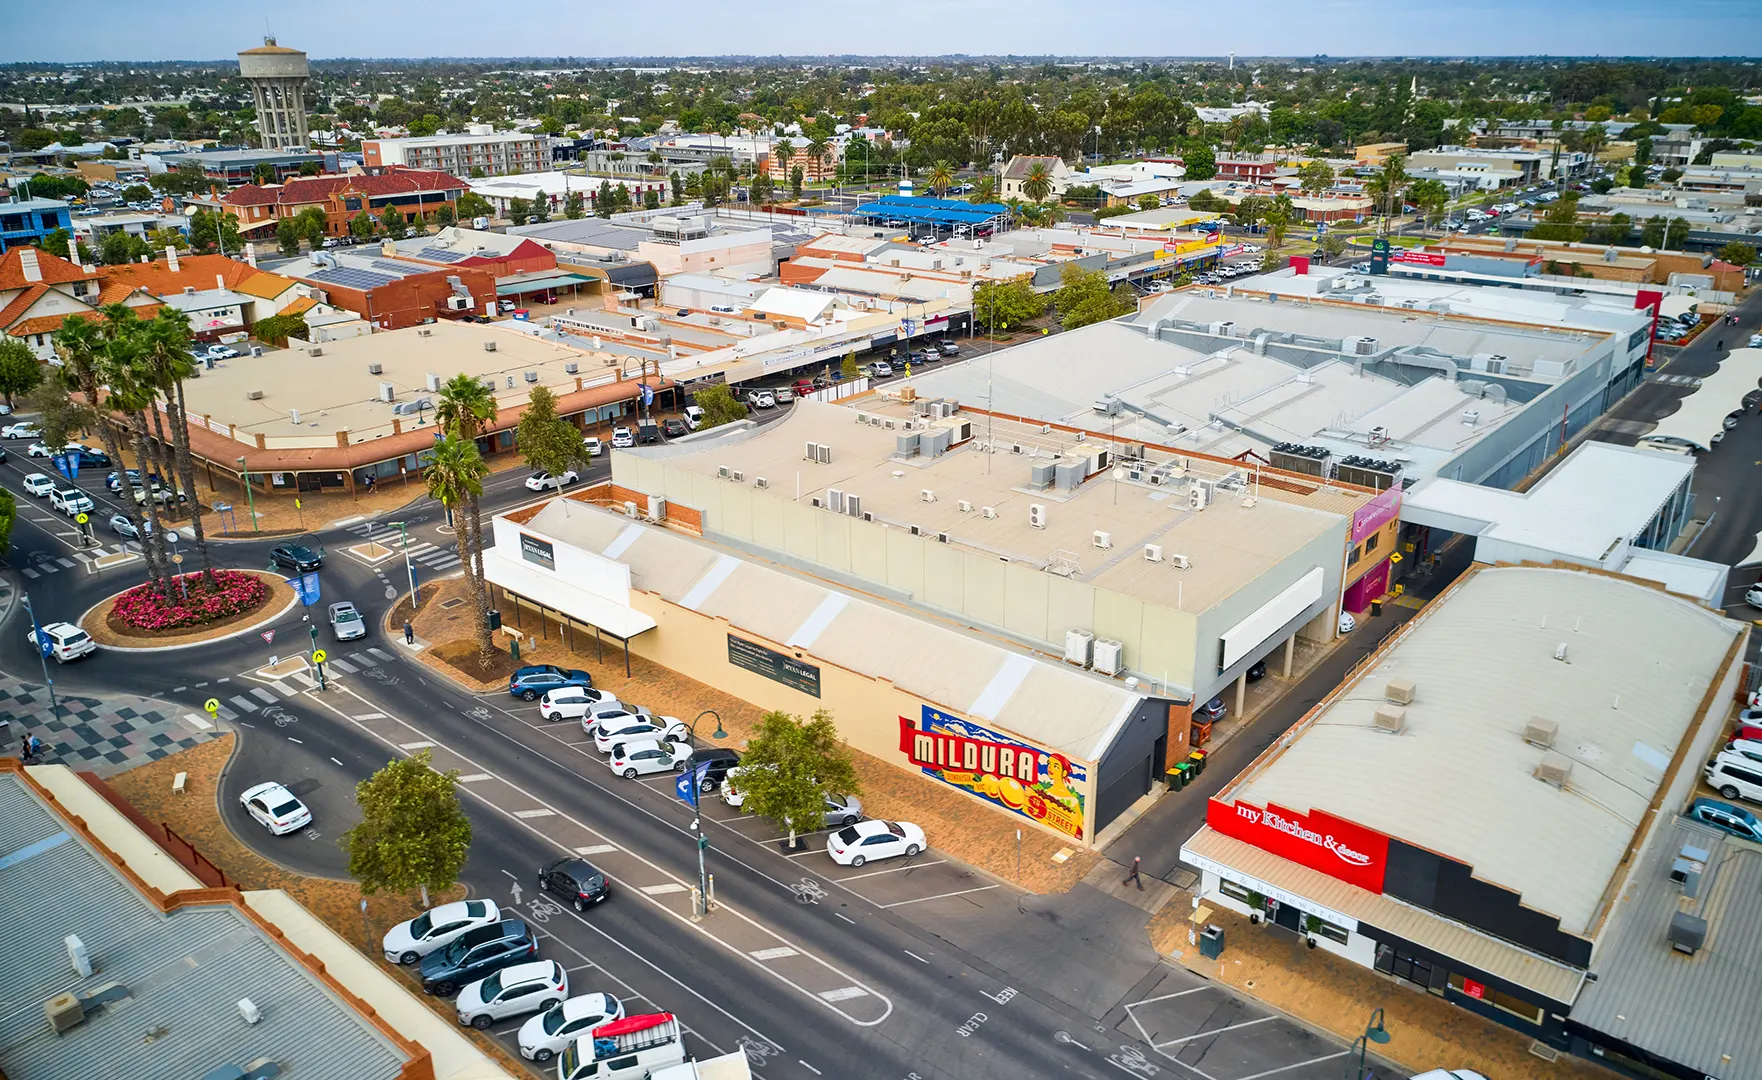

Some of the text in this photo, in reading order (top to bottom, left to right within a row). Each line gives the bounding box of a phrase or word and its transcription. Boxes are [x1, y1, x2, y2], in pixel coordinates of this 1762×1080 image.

[786, 664, 800, 675] RYAN
[800, 669, 816, 681] LEGAL
[914, 734, 1034, 783] MILDURA
[1048, 811, 1073, 831] STREET
[1236, 805, 1261, 824] my
[1262, 811, 1323, 846] Kitchen
[1191, 856, 1344, 924] decor & homewares
[980, 986, 1018, 1005] KEEP
[956, 1012, 988, 1036] CLEAR
